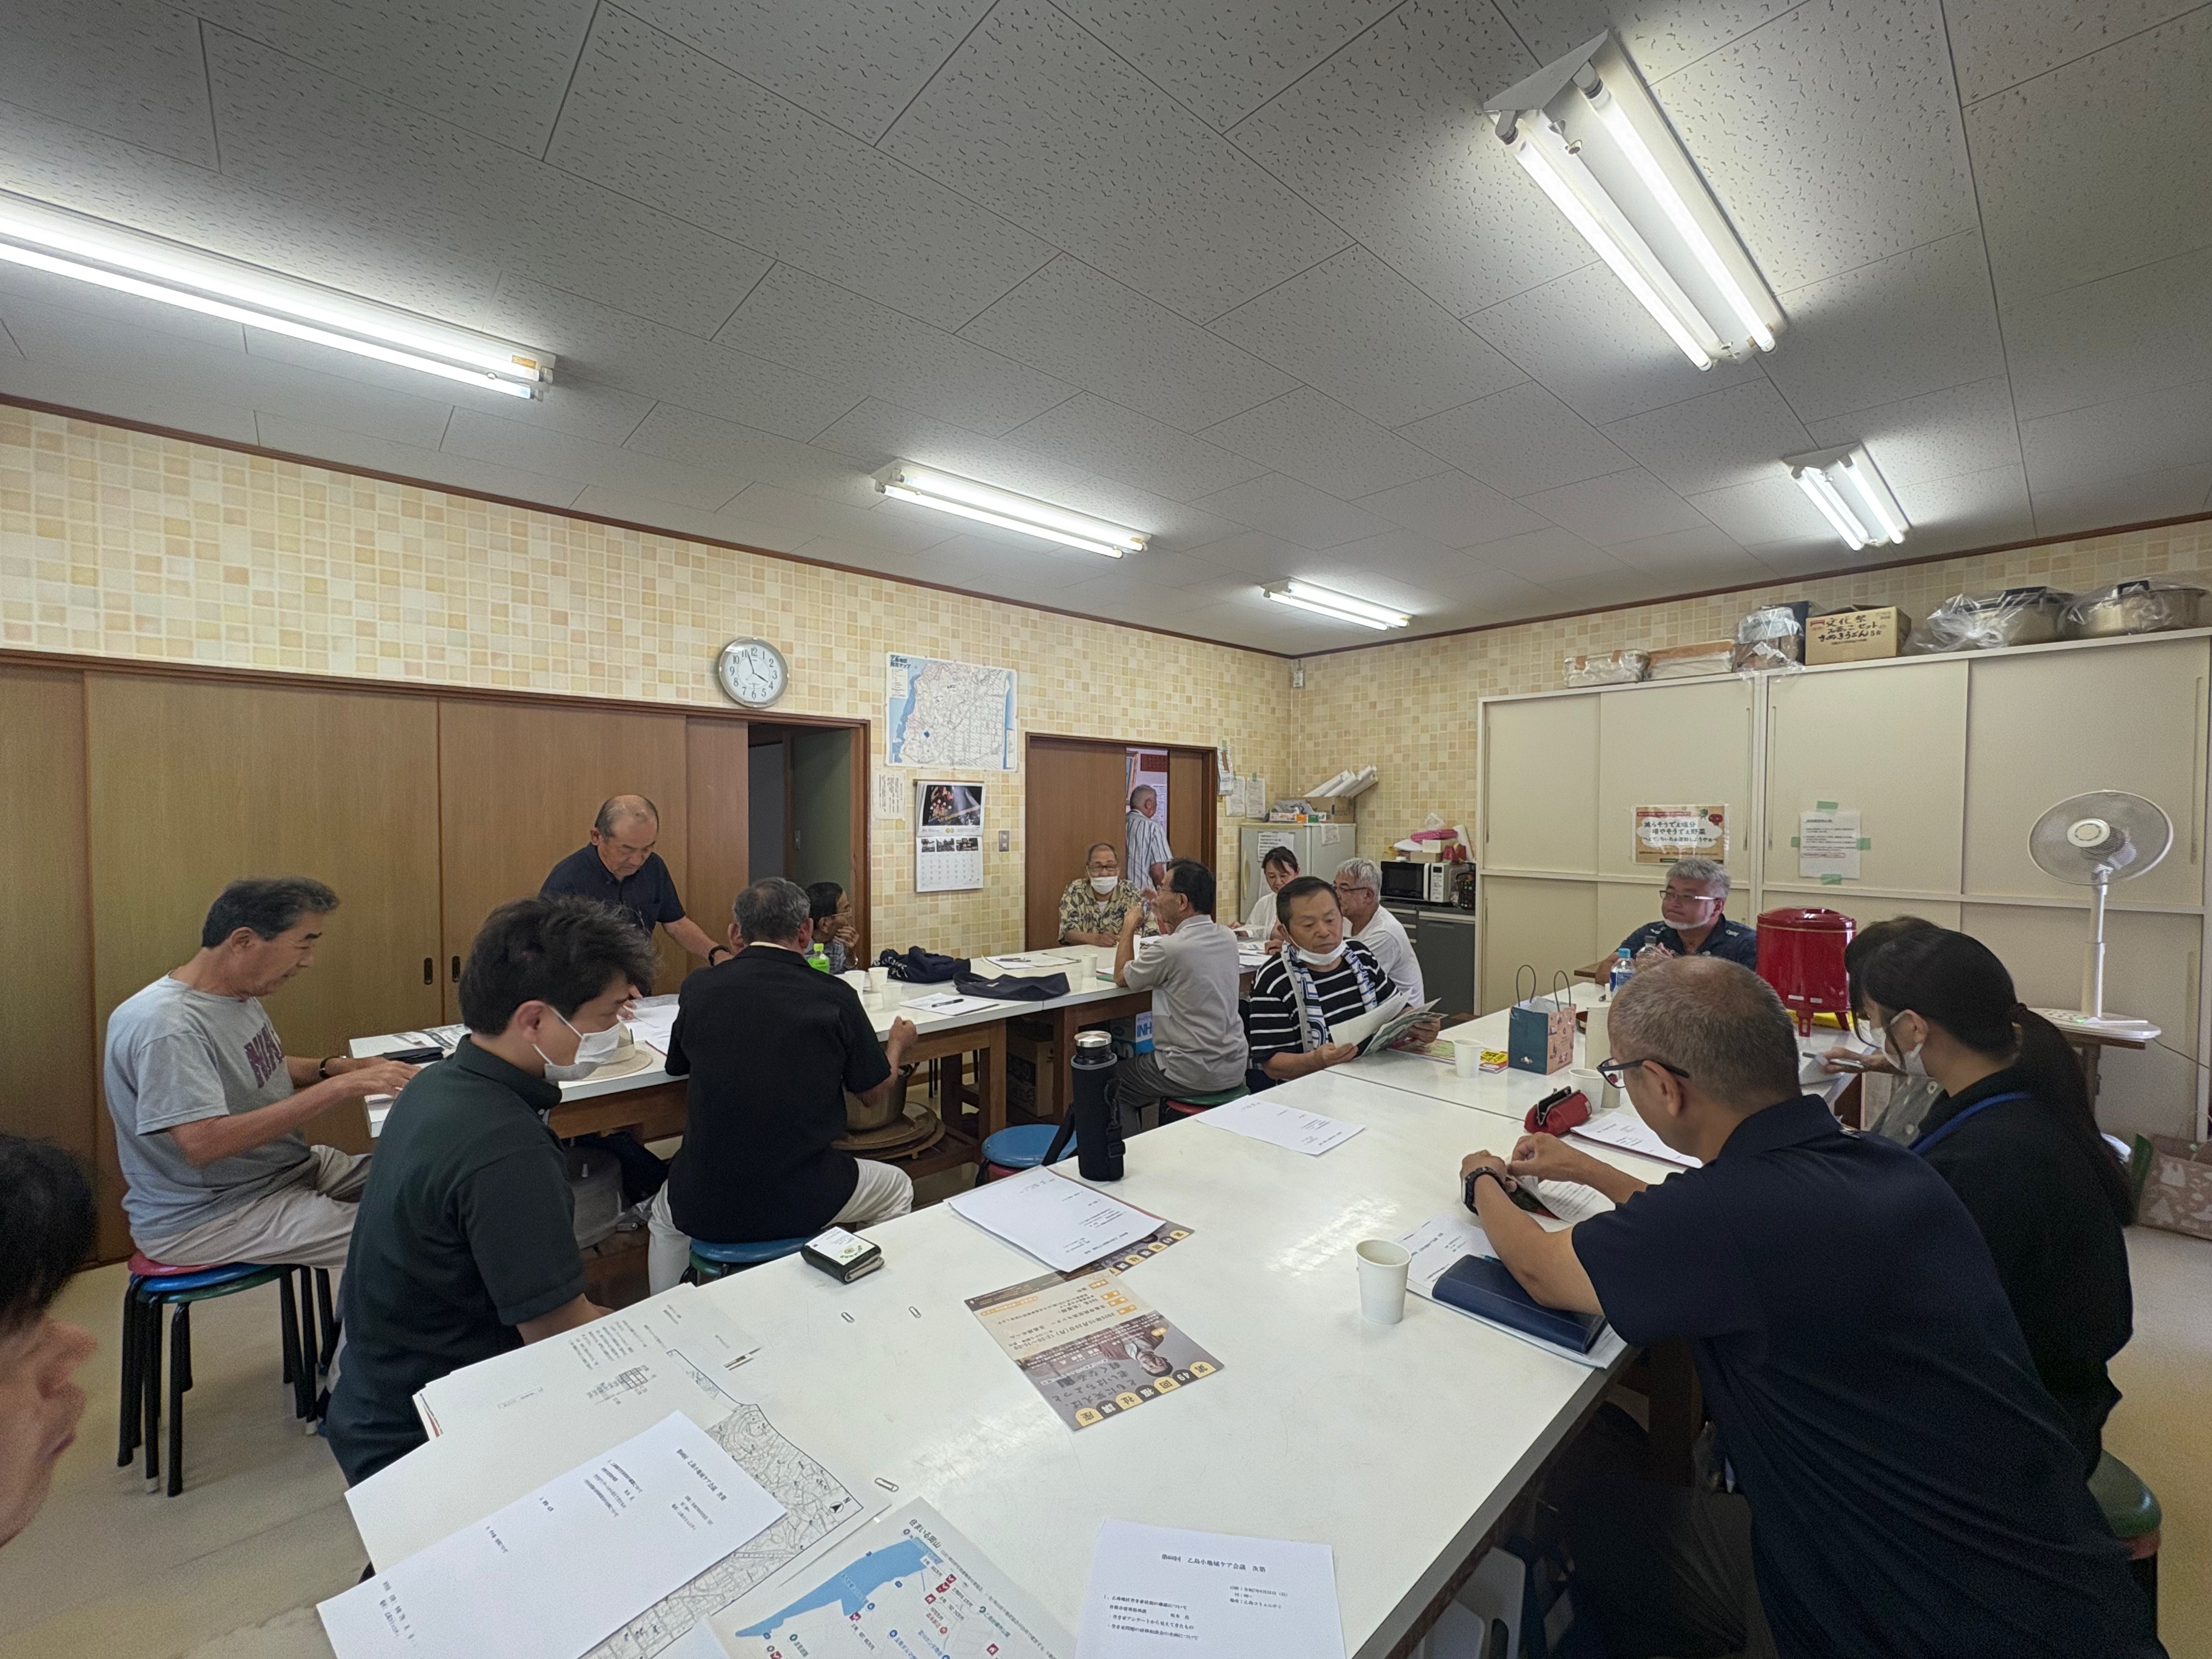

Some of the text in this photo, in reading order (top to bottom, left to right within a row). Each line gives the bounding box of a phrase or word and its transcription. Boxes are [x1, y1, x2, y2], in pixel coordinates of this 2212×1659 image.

[751, 648, 758, 656] 12
[763, 651, 765, 659] 1
[733, 655, 739, 664] 10
[769, 658, 774, 667] 2
[730, 667, 735, 676] 9
[772, 670, 777, 679] 3
[733, 678, 738, 686] 8
[769, 681, 773, 690] 4
[742, 687, 747, 696] 7
[752, 690, 756, 699] 6
[761, 689, 766, 697] 5
[1050, 1369, 1130, 1404] 老いはちょっと
[1079, 1363, 1209, 1423] 第49回福祉講座
[909, 1517, 942, 1549] 住まいる岡山
